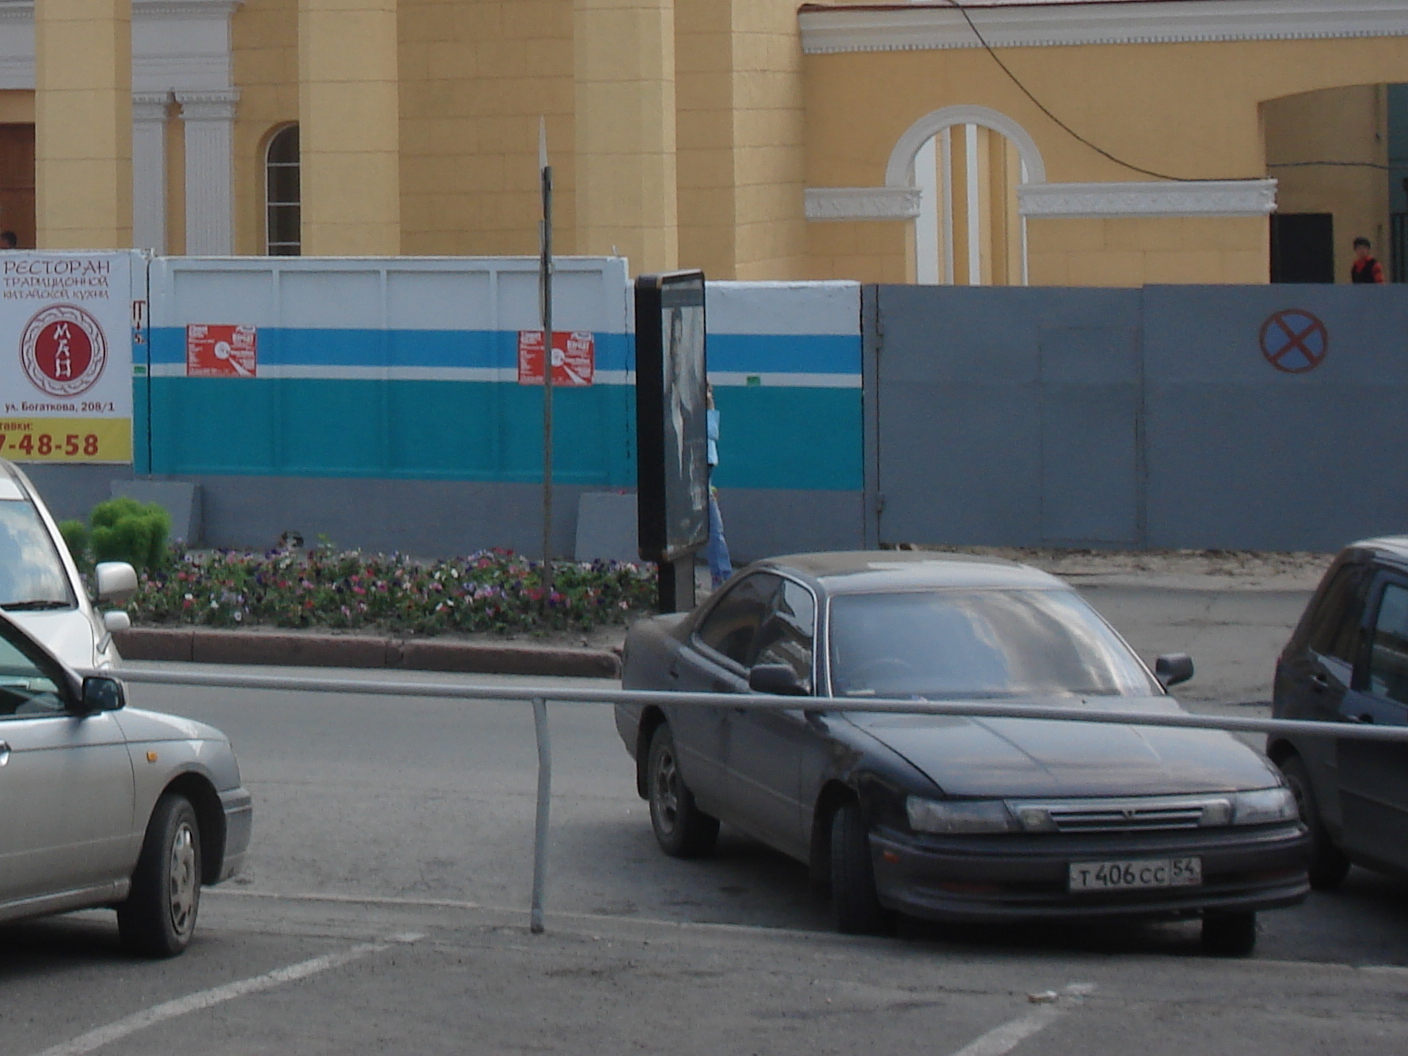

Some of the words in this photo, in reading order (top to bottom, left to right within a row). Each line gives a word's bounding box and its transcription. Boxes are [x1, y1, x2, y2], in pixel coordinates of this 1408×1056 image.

[3, 259, 110, 276] РЕСТОРАН
[21, 401, 79, 414] Богаткова,
[81, 402, 116, 414] 208/1
